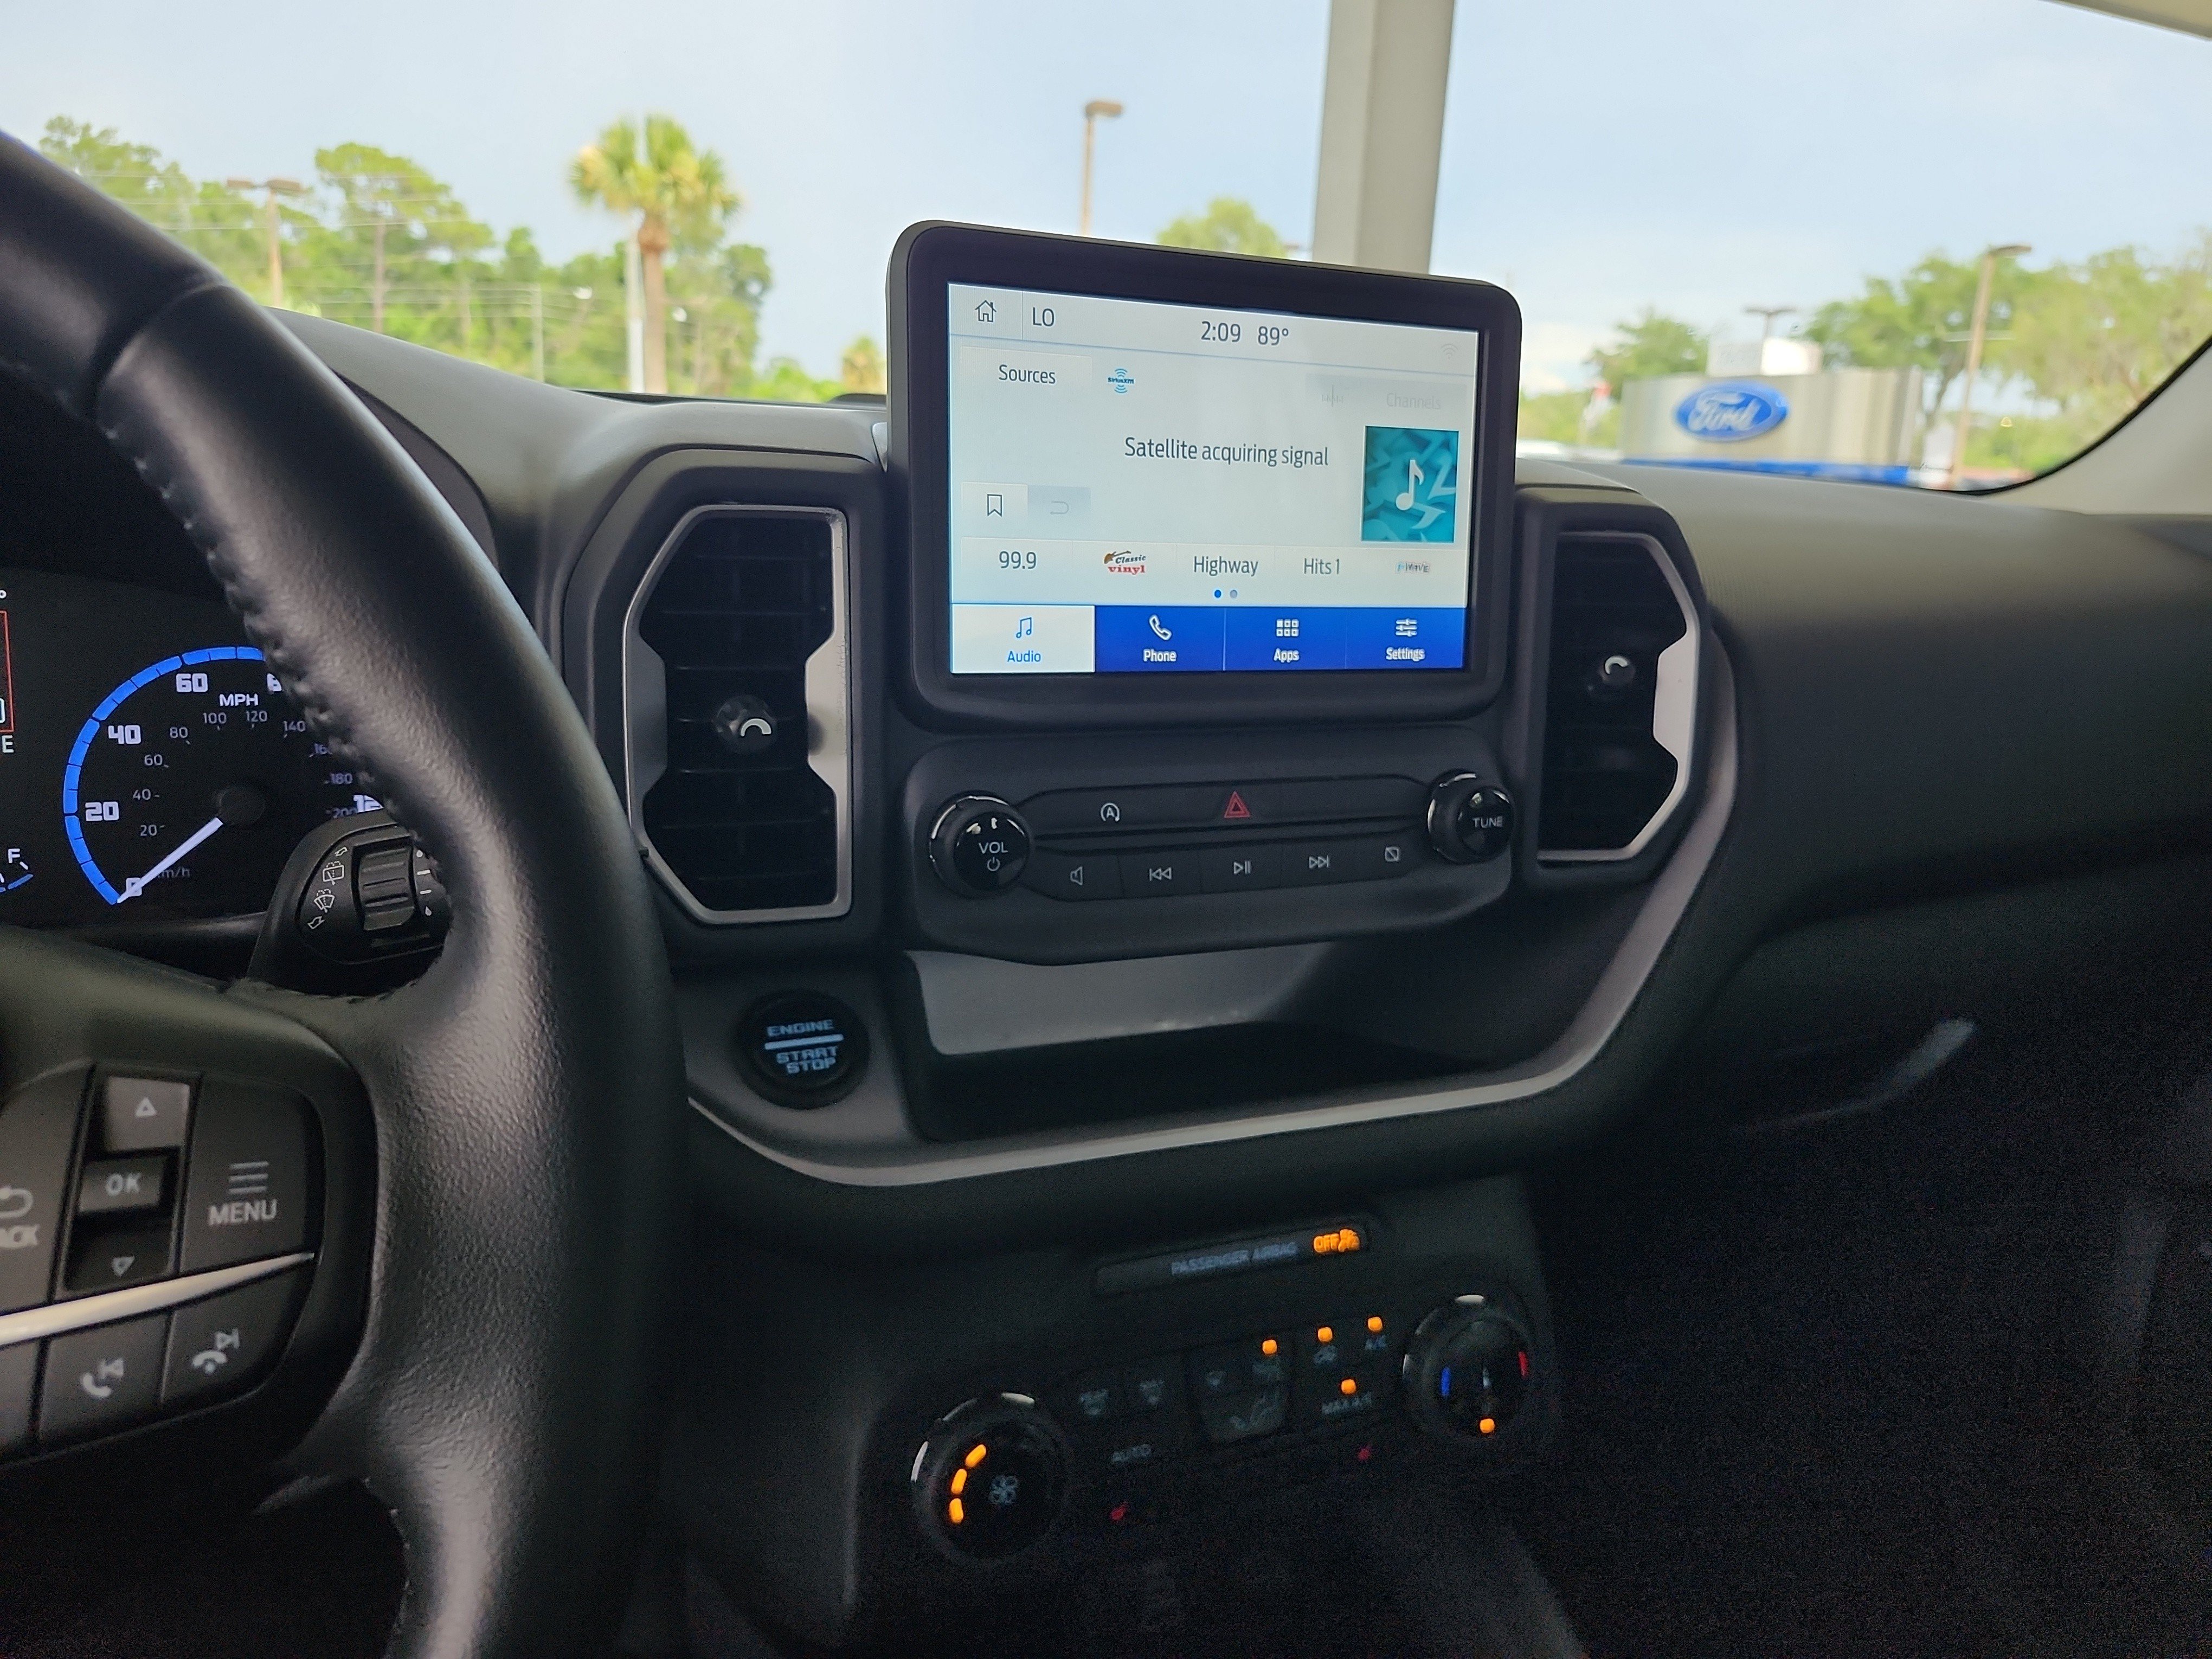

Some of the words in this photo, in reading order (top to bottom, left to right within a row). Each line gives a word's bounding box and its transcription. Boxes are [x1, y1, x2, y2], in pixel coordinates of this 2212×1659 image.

[1032, 307, 1055, 327] LO
[1200, 321, 1242, 343] 2:09
[1257, 325, 1289, 346] 89°
[998, 364, 1056, 384] Sources
[1386, 393, 1441, 410] Channels
[1687, 391, 1761, 432] Ford
[1124, 437, 1198, 460] Satellite
[1201, 442, 1277, 468] acquiring
[1281, 446, 1329, 468] signal
[999, 551, 1037, 570] 99.9
[1115, 554, 1147, 564] Classic
[1193, 556, 1258, 577] Highway
[1304, 558, 1332, 575] Hits
[1108, 564, 1146, 575] vinyl
[1007, 650, 1041, 664] Audio
[1143, 649, 1177, 663] Phone
[1273, 648, 1300, 664] Apps
[1385, 647, 1426, 663] Settings
[176, 673, 209, 693] 60
[219, 693, 259, 706] MPH
[203, 712, 227, 724] 100
[246, 710, 268, 722] 120
[169, 726, 189, 739] 80
[283, 720, 306, 732] 140
[108, 724, 142, 745] 40
[2, 735, 15, 754] E
[144, 754, 164, 767] 60
[330, 773, 353, 785] 180
[132, 789, 151, 801] 40
[85, 801, 119, 822] 20
[1472, 815, 1503, 828] TUNE
[139, 824, 158, 837] 20
[8, 848, 21, 863] F
[978, 841, 1009, 854] VOL
[767, 1019, 834, 1036] ENGINE
[777, 1046, 837, 1064] START
[787, 1058, 836, 1074] STOP
[106, 1172, 142, 1196] OK
[207, 1199, 279, 1227] MENU
[1313, 1233, 1340, 1253] OFF
